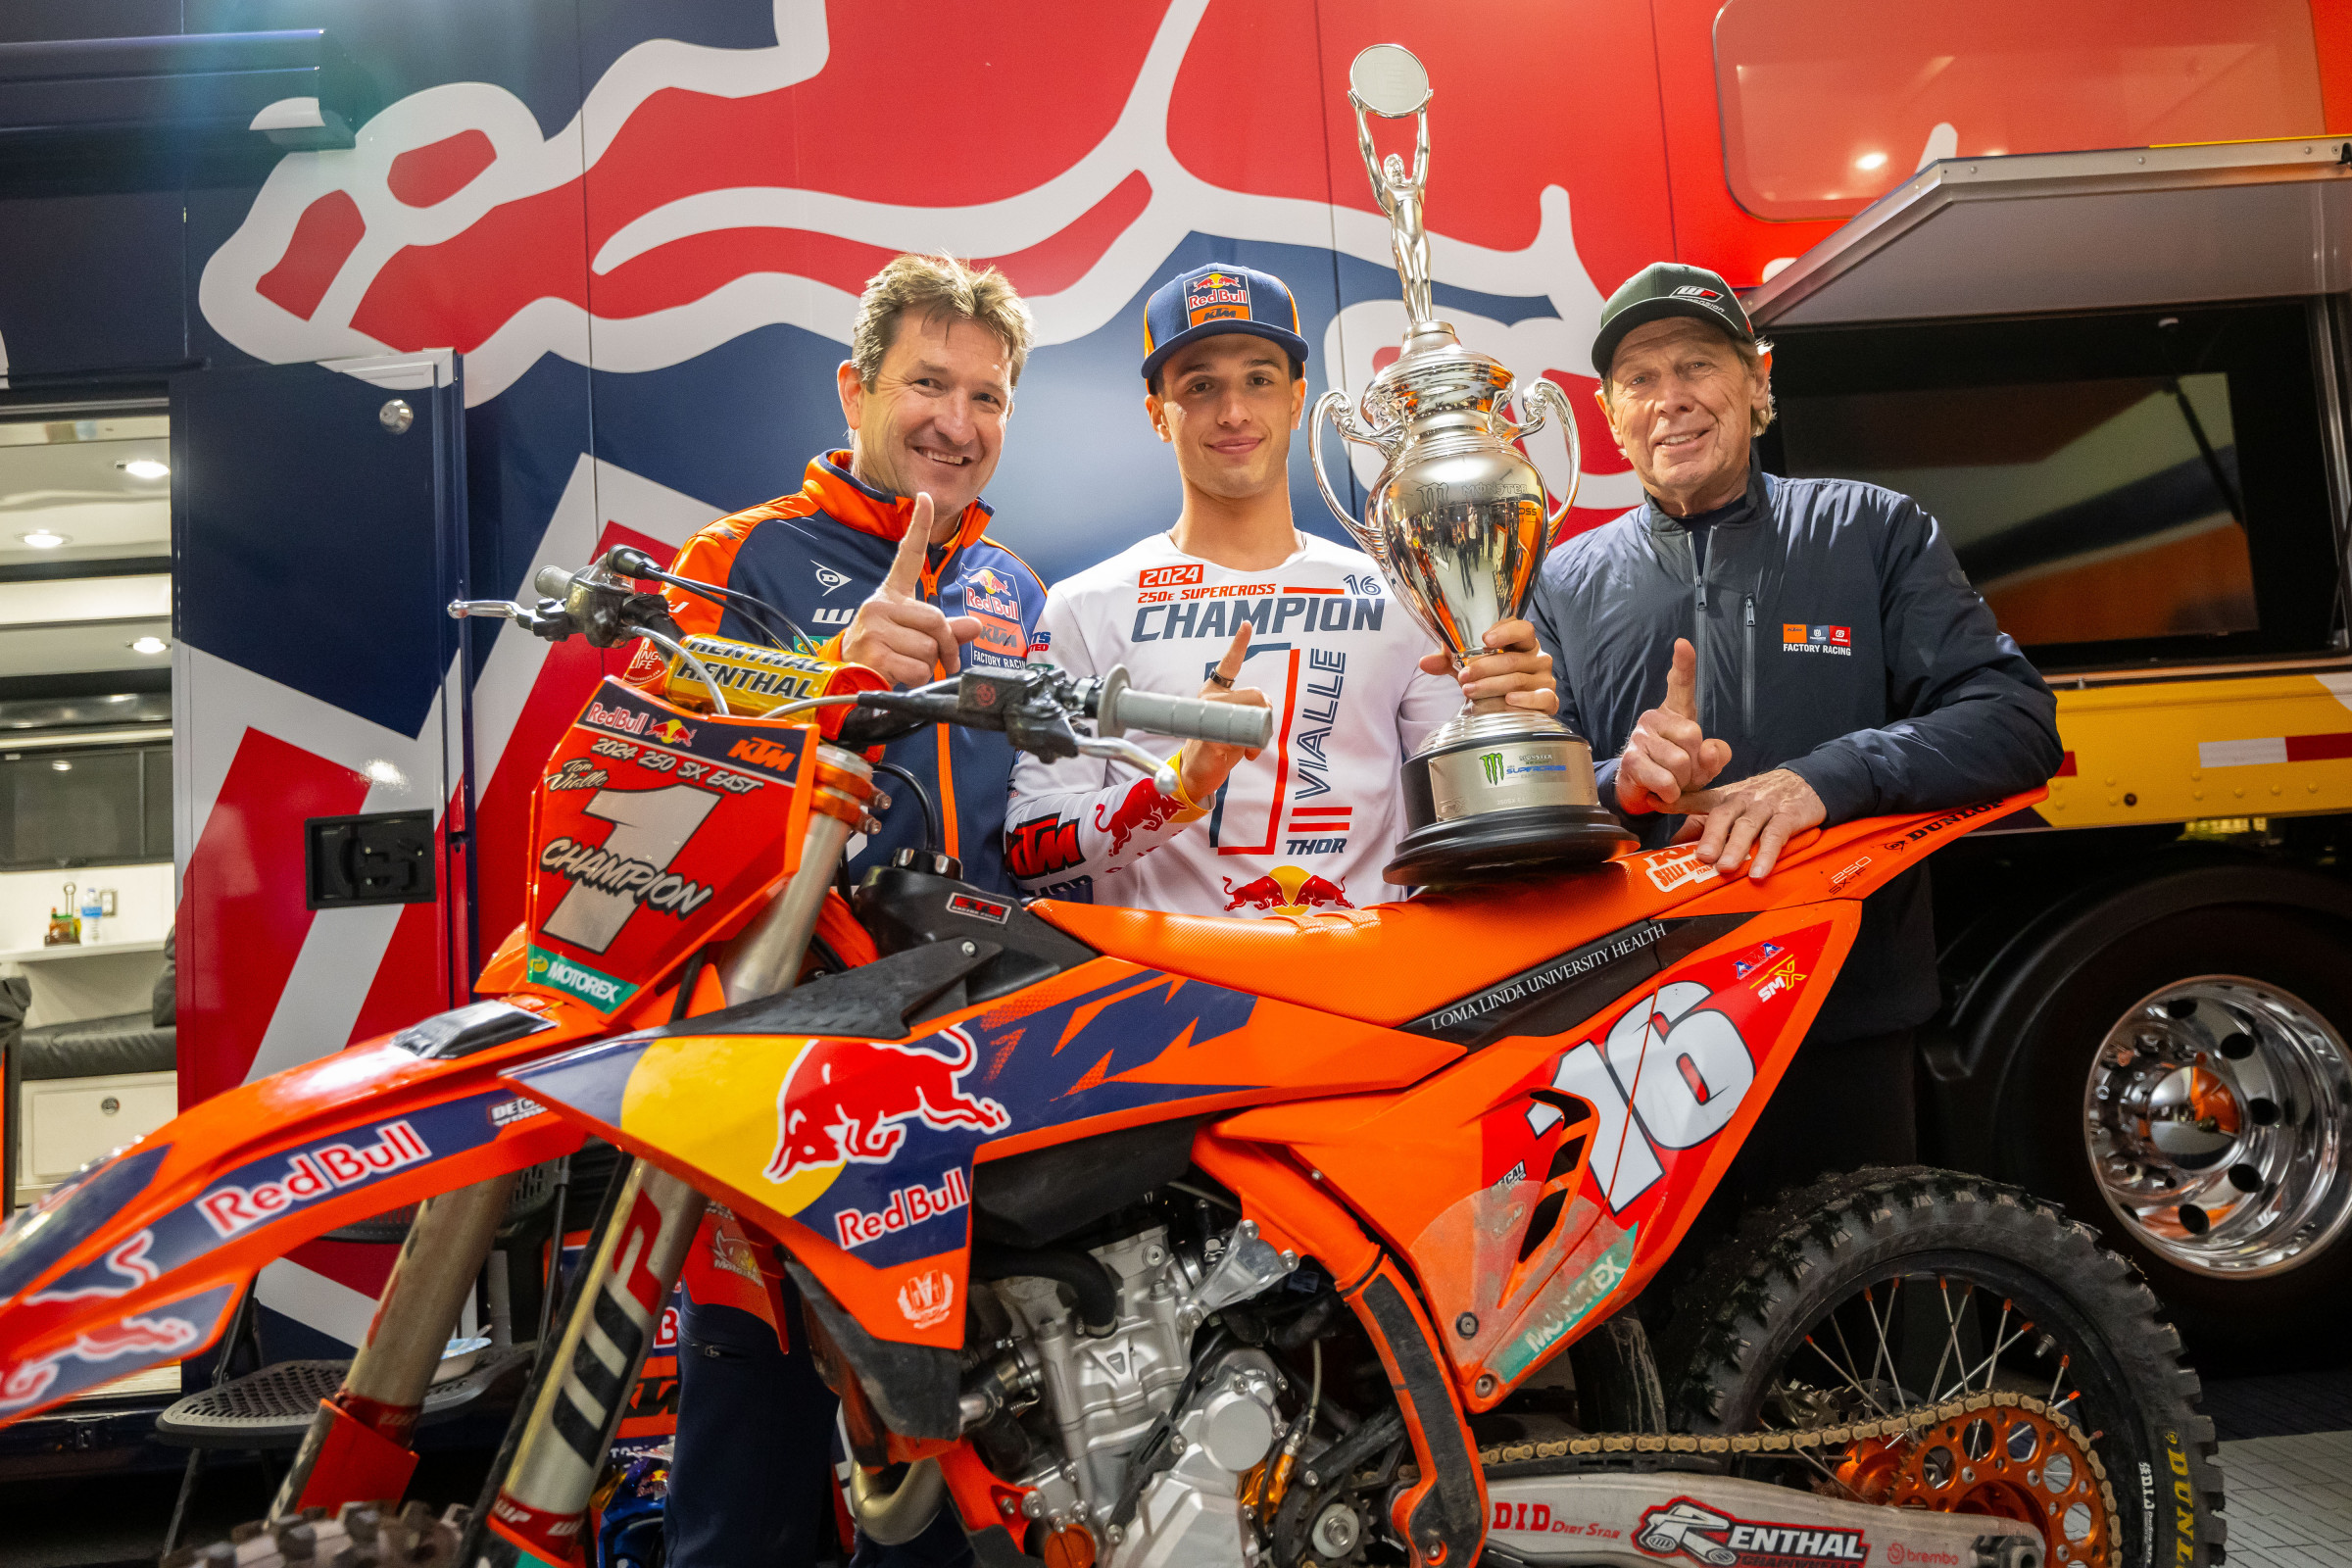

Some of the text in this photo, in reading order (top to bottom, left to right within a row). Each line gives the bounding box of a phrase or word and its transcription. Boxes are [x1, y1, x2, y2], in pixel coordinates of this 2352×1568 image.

[1189, 289, 1248, 311] Red Bull
[1203, 308, 1237, 321] KTM
[1144, 566, 1200, 586] 2024
[1180, 584, 1277, 600] SUPERCROSS
[1344, 574, 1383, 596] 16
[965, 586, 1019, 620] Red Bull
[1131, 598, 1386, 643] CHAMPION
[980, 623, 1018, 648] KTM
[1783, 643, 1851, 657] FACTORY RACING
[973, 650, 1027, 669] FACTORY RACIN
[674, 661, 813, 700] RENTHAL
[586, 702, 649, 735] Red Bull
[1295, 648, 1347, 801] VIALLE
[590, 737, 764, 794] 2024 250 SX EAST
[727, 737, 797, 772] KTM
[1286, 838, 1348, 857] THOR
[540, 783, 725, 956] 1
[540, 837, 713, 920] CHAMPION
[1829, 867, 1867, 896] SX-F
[1830, 856, 1872, 884] 250
[547, 960, 621, 1004] MOTOREX
[1431, 922, 1666, 1030] LOMA LINDA UNIVERSITY HEALTH
[1757, 959, 1808, 1003] SMX
[1525, 980, 1756, 1217] 16
[196, 1120, 433, 1239] Red Bull
[835, 1166, 970, 1250] Red Bull
[2168, 1447, 2194, 1568] DUNL
[1638, 1502, 1864, 1566] RENTHAL
[1906, 1547, 1959, 1566] brembo
